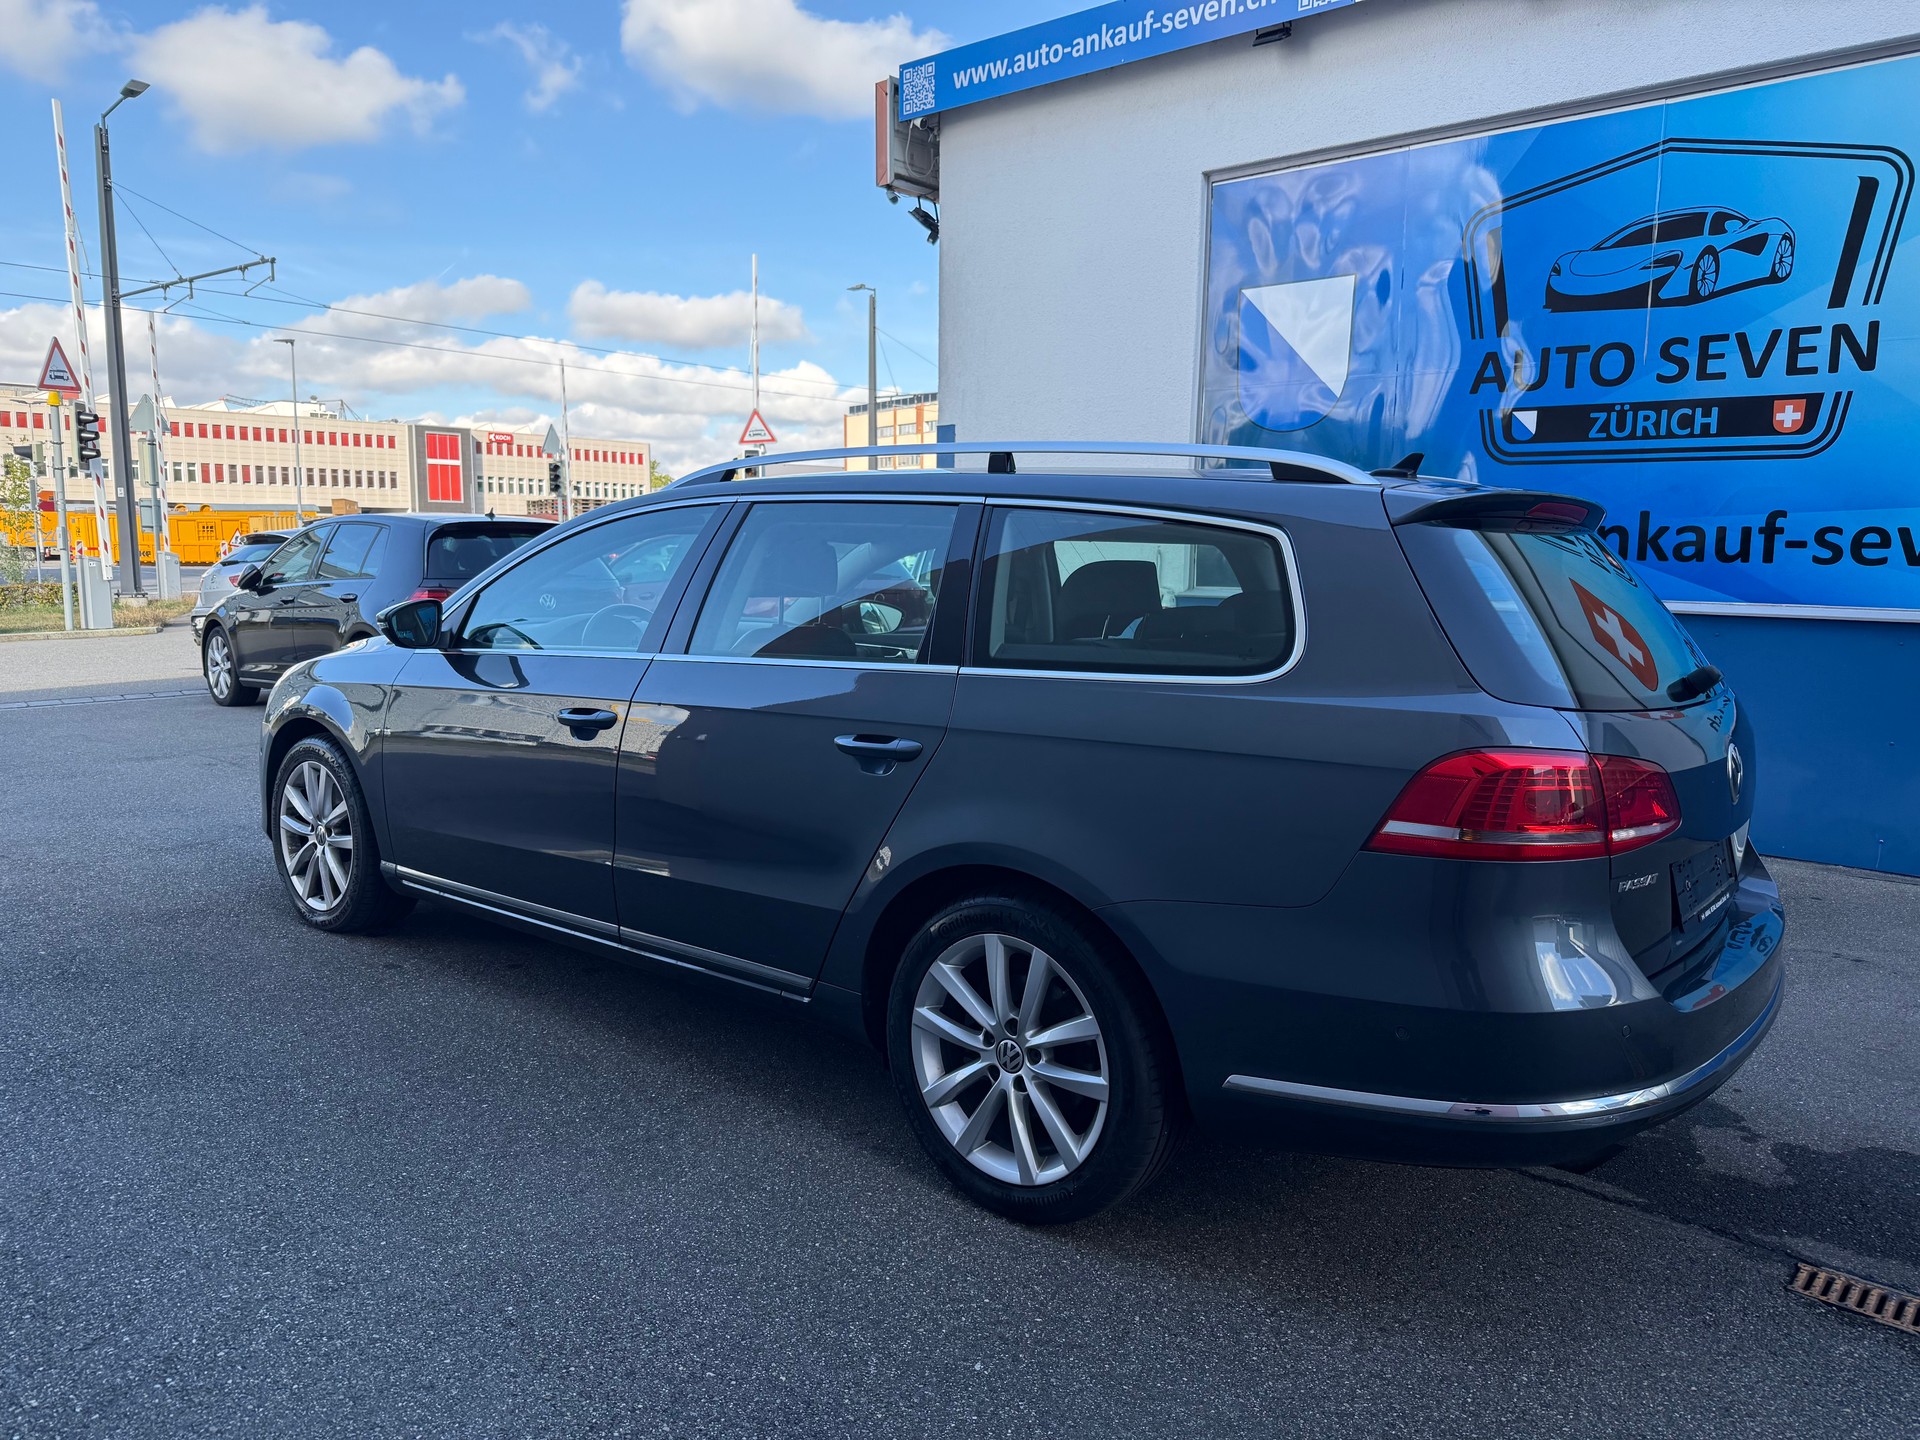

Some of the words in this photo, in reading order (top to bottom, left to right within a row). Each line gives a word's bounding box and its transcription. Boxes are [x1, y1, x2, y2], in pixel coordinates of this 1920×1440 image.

[952, 0, 1276, 90] www.auto-ankauf-seven.
[1469, 342, 1636, 395] AUTO
[1655, 320, 1881, 384] SEVEN
[1588, 404, 1719, 439] ZÜRICH
[1618, 873, 1659, 892] PASSAT
